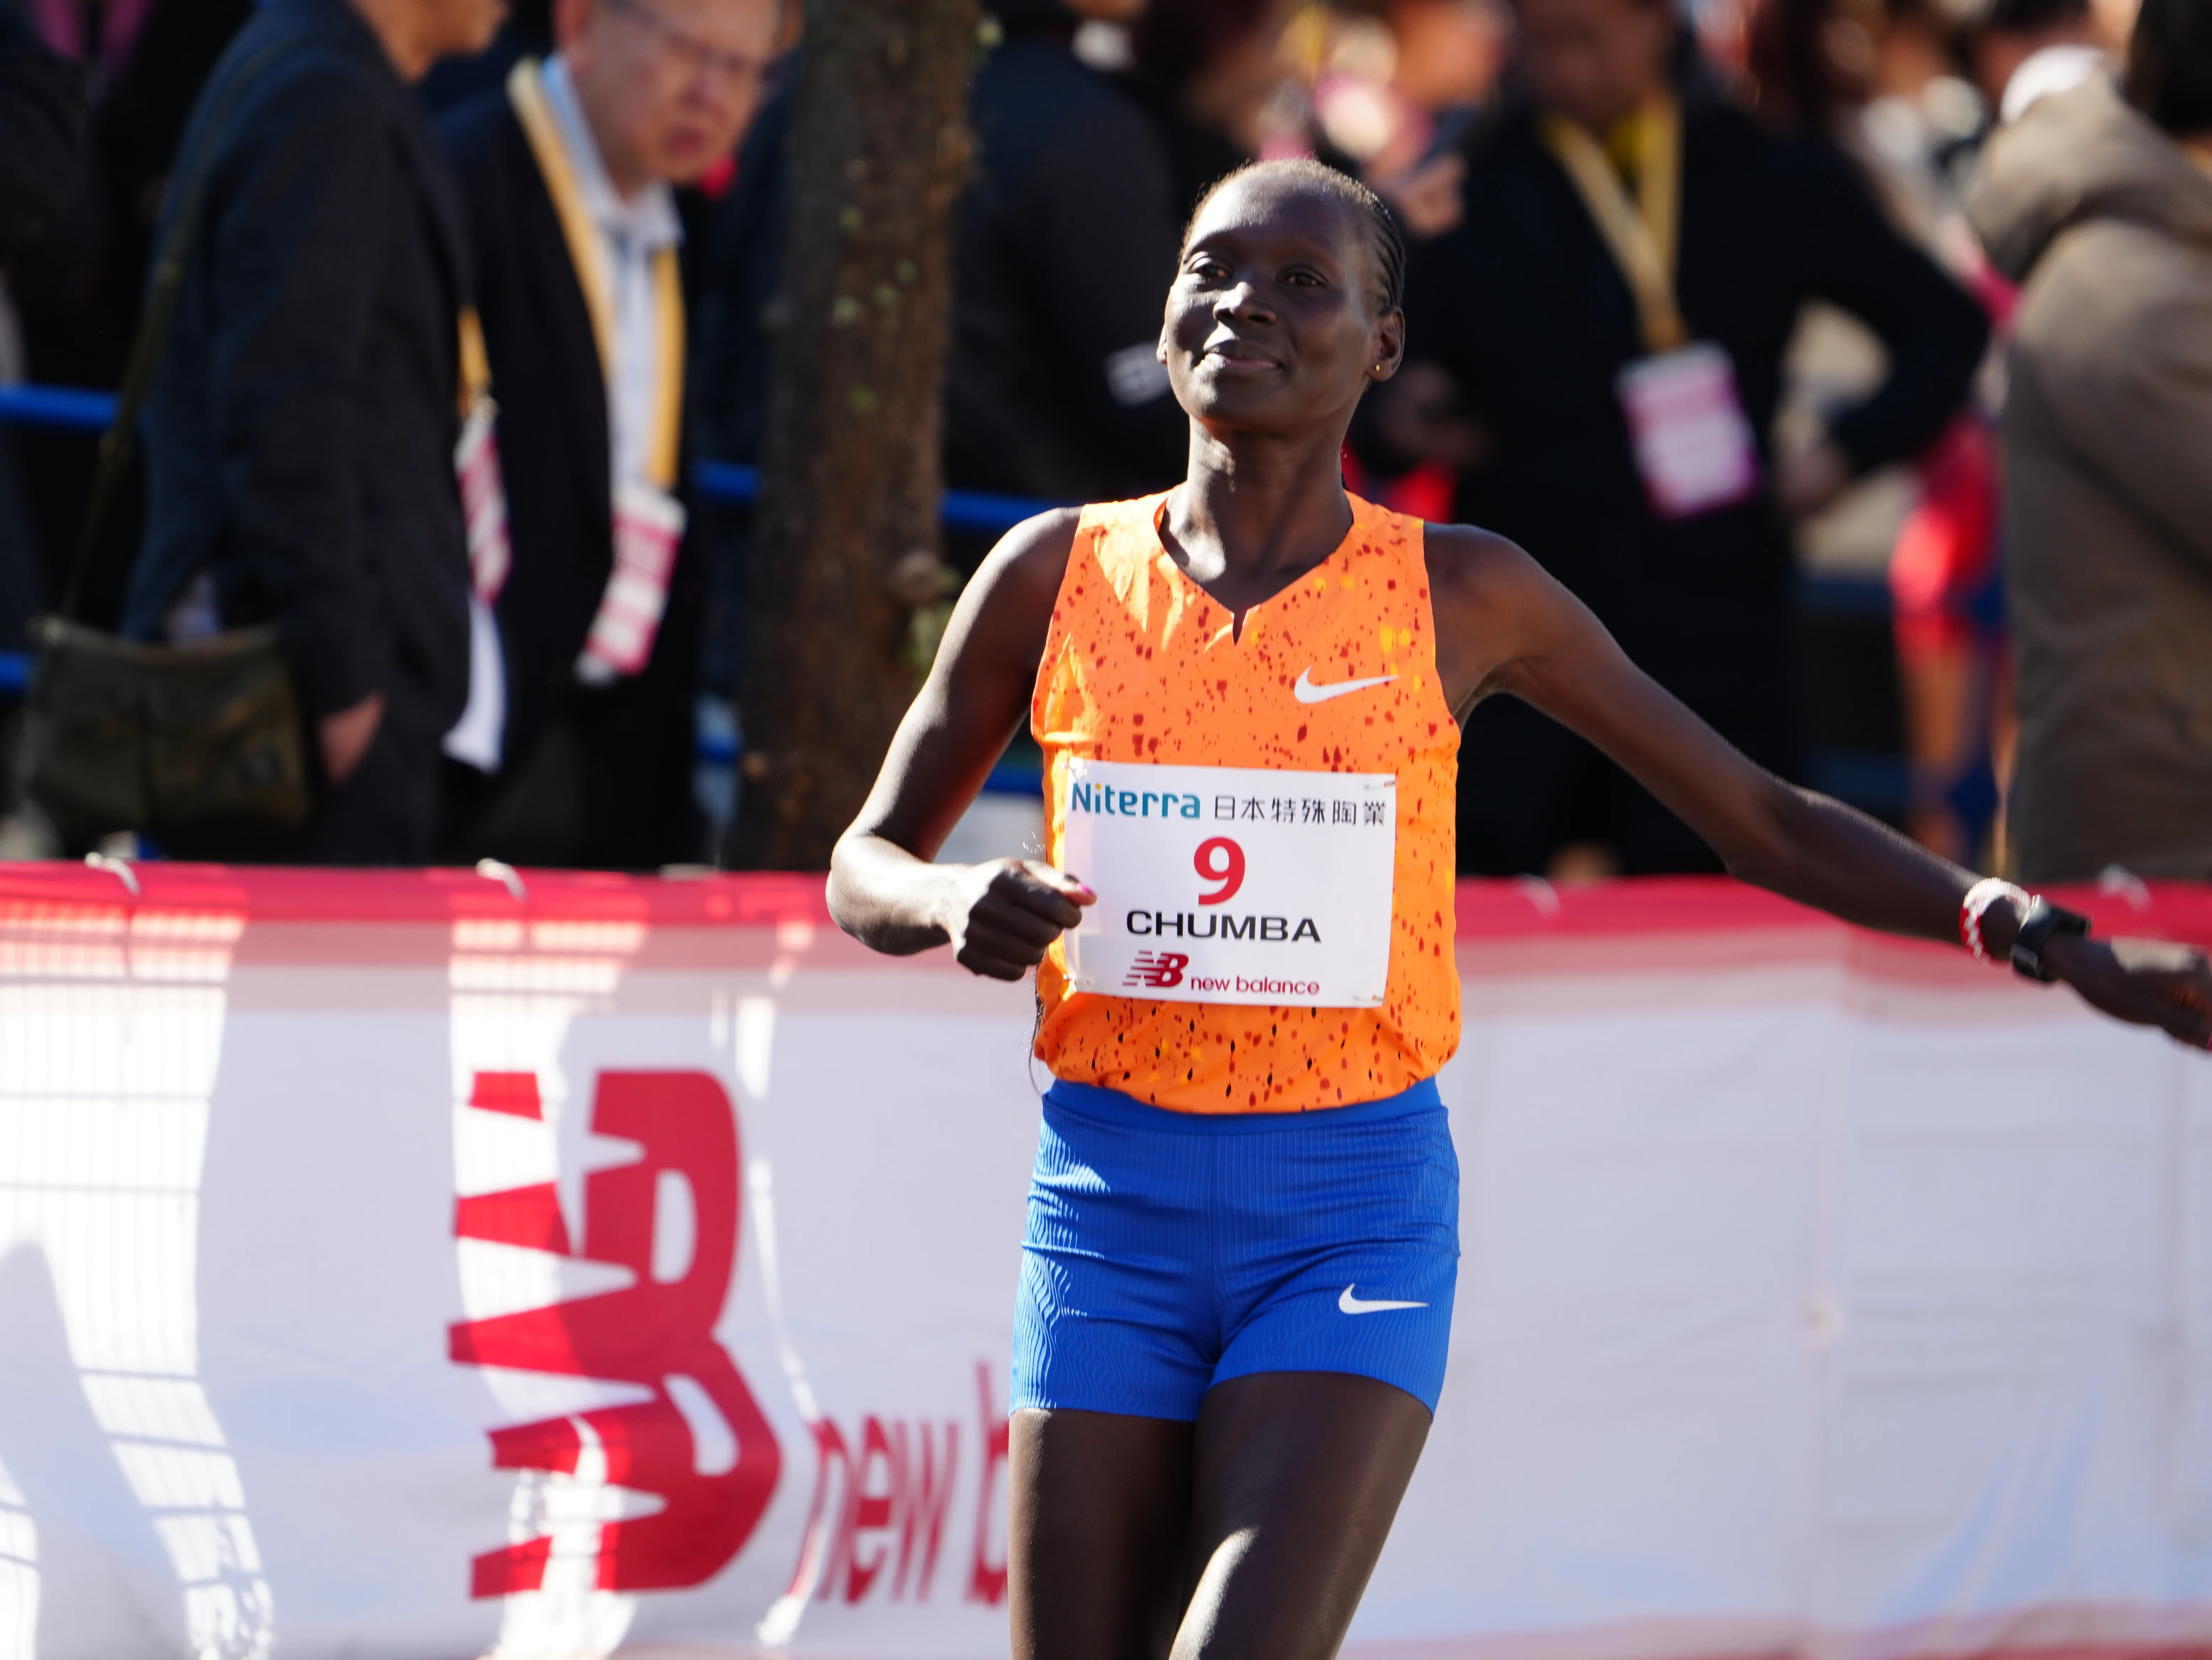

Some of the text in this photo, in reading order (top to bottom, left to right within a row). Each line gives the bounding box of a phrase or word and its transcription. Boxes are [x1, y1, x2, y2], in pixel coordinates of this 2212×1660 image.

[1071, 782, 1201, 819] Niterra
[1214, 795, 1385, 826] 日本特殊陶業
[1193, 836, 1246, 906] 9
[1126, 910, 1321, 943] CHUMBA
[1190, 975, 1320, 995] new balance
[785, 1414, 960, 1607] new
